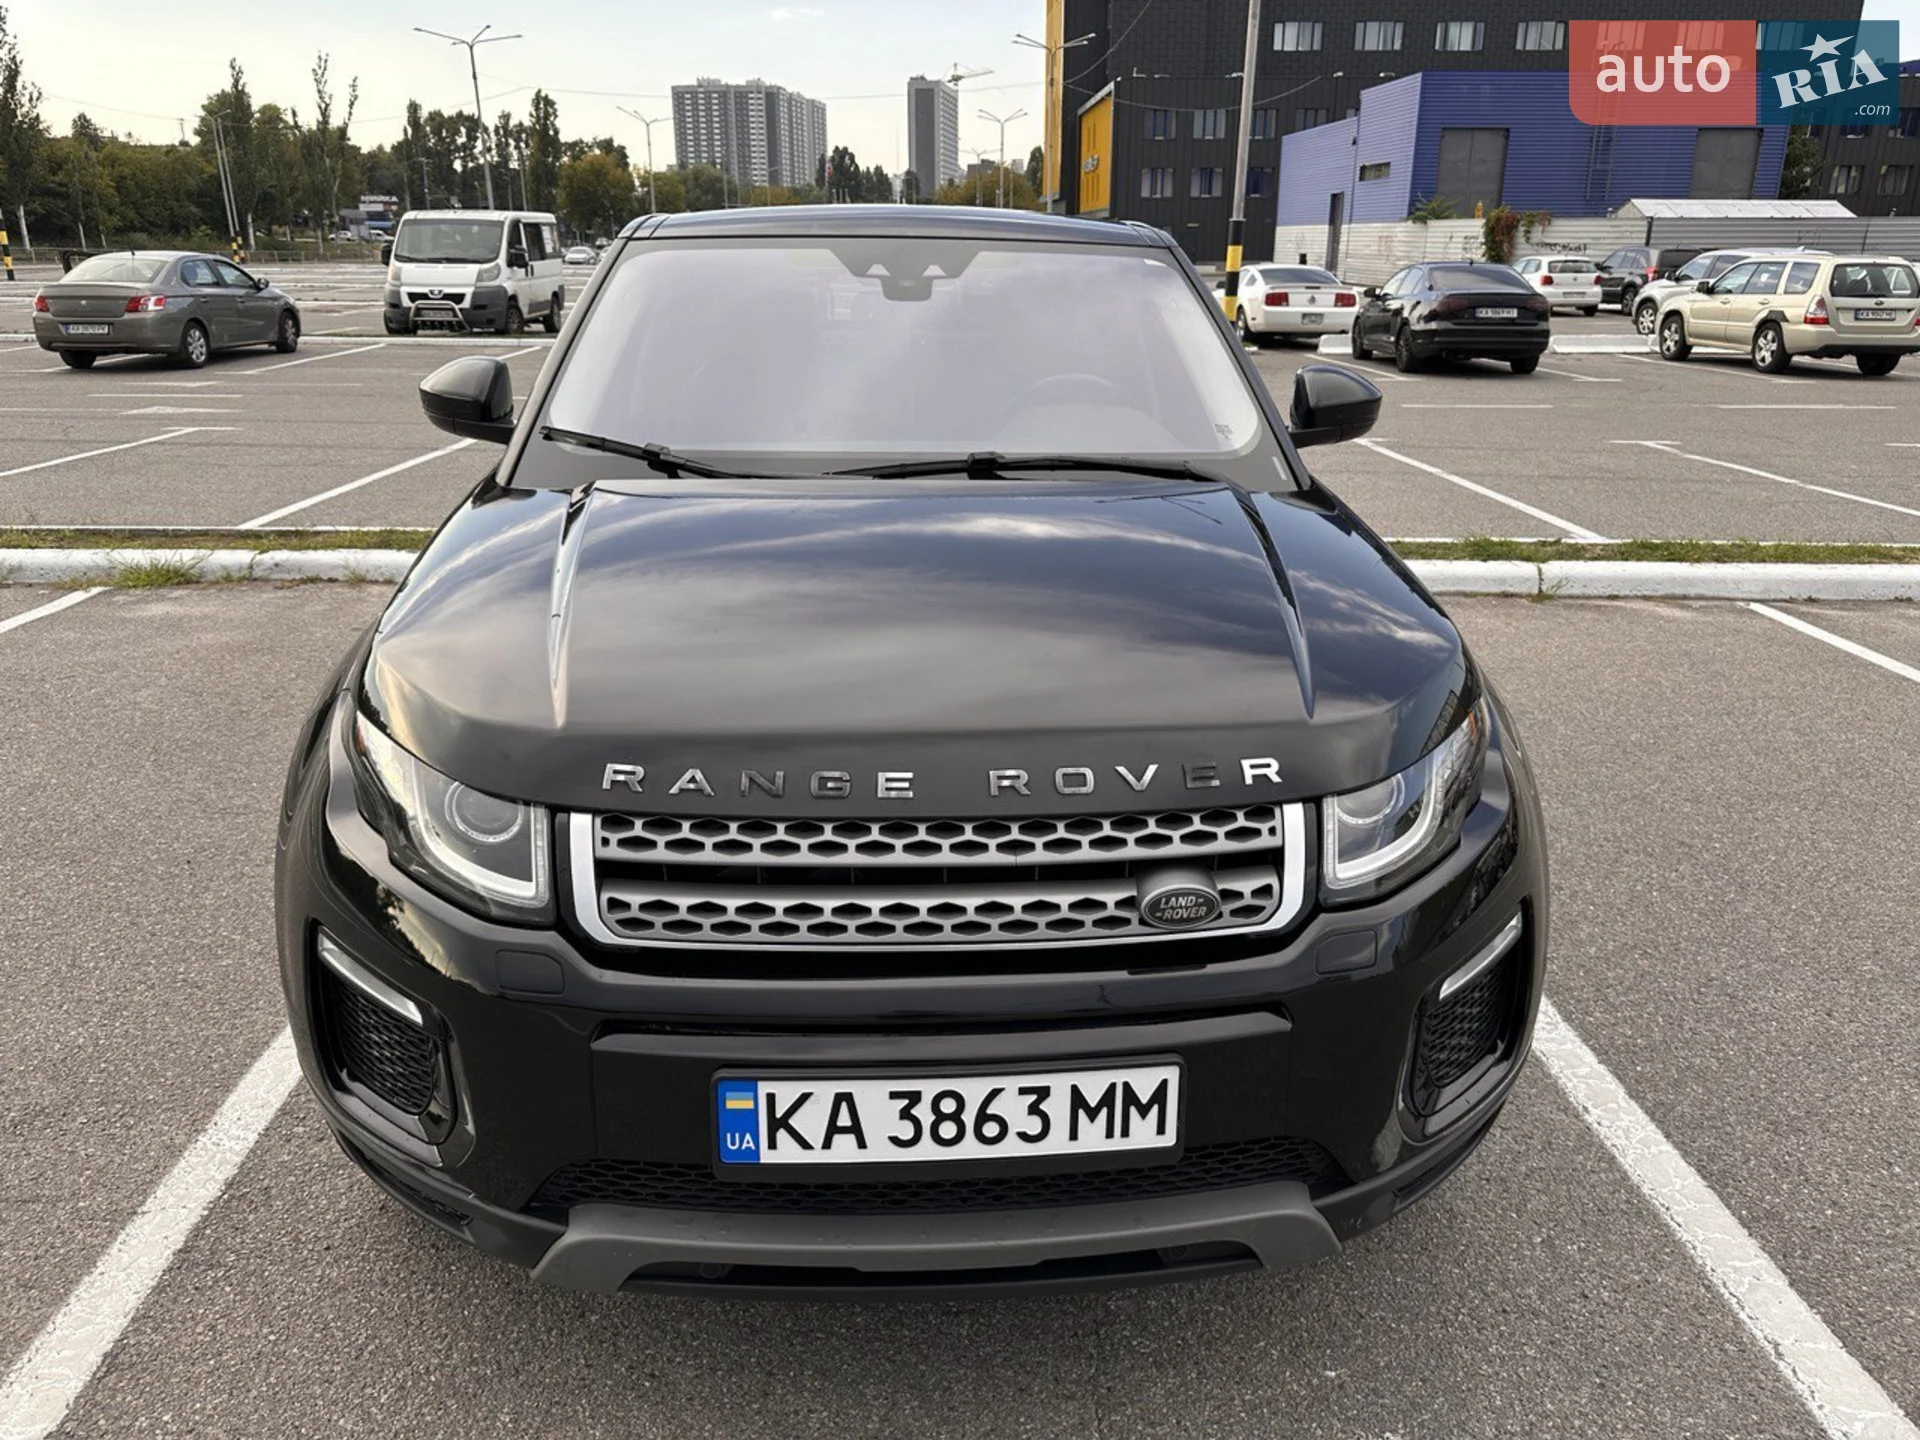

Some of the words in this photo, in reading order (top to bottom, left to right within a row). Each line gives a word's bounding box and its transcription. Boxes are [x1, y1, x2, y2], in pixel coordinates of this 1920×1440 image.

[602, 762, 914, 799] RANGE
[988, 756, 1283, 796] ROVER
[726, 1132, 756, 1150] UA
[765, 1091, 868, 1151] KA
[887, 1085, 1052, 1149] 3863
[1069, 1078, 1169, 1142] MM
